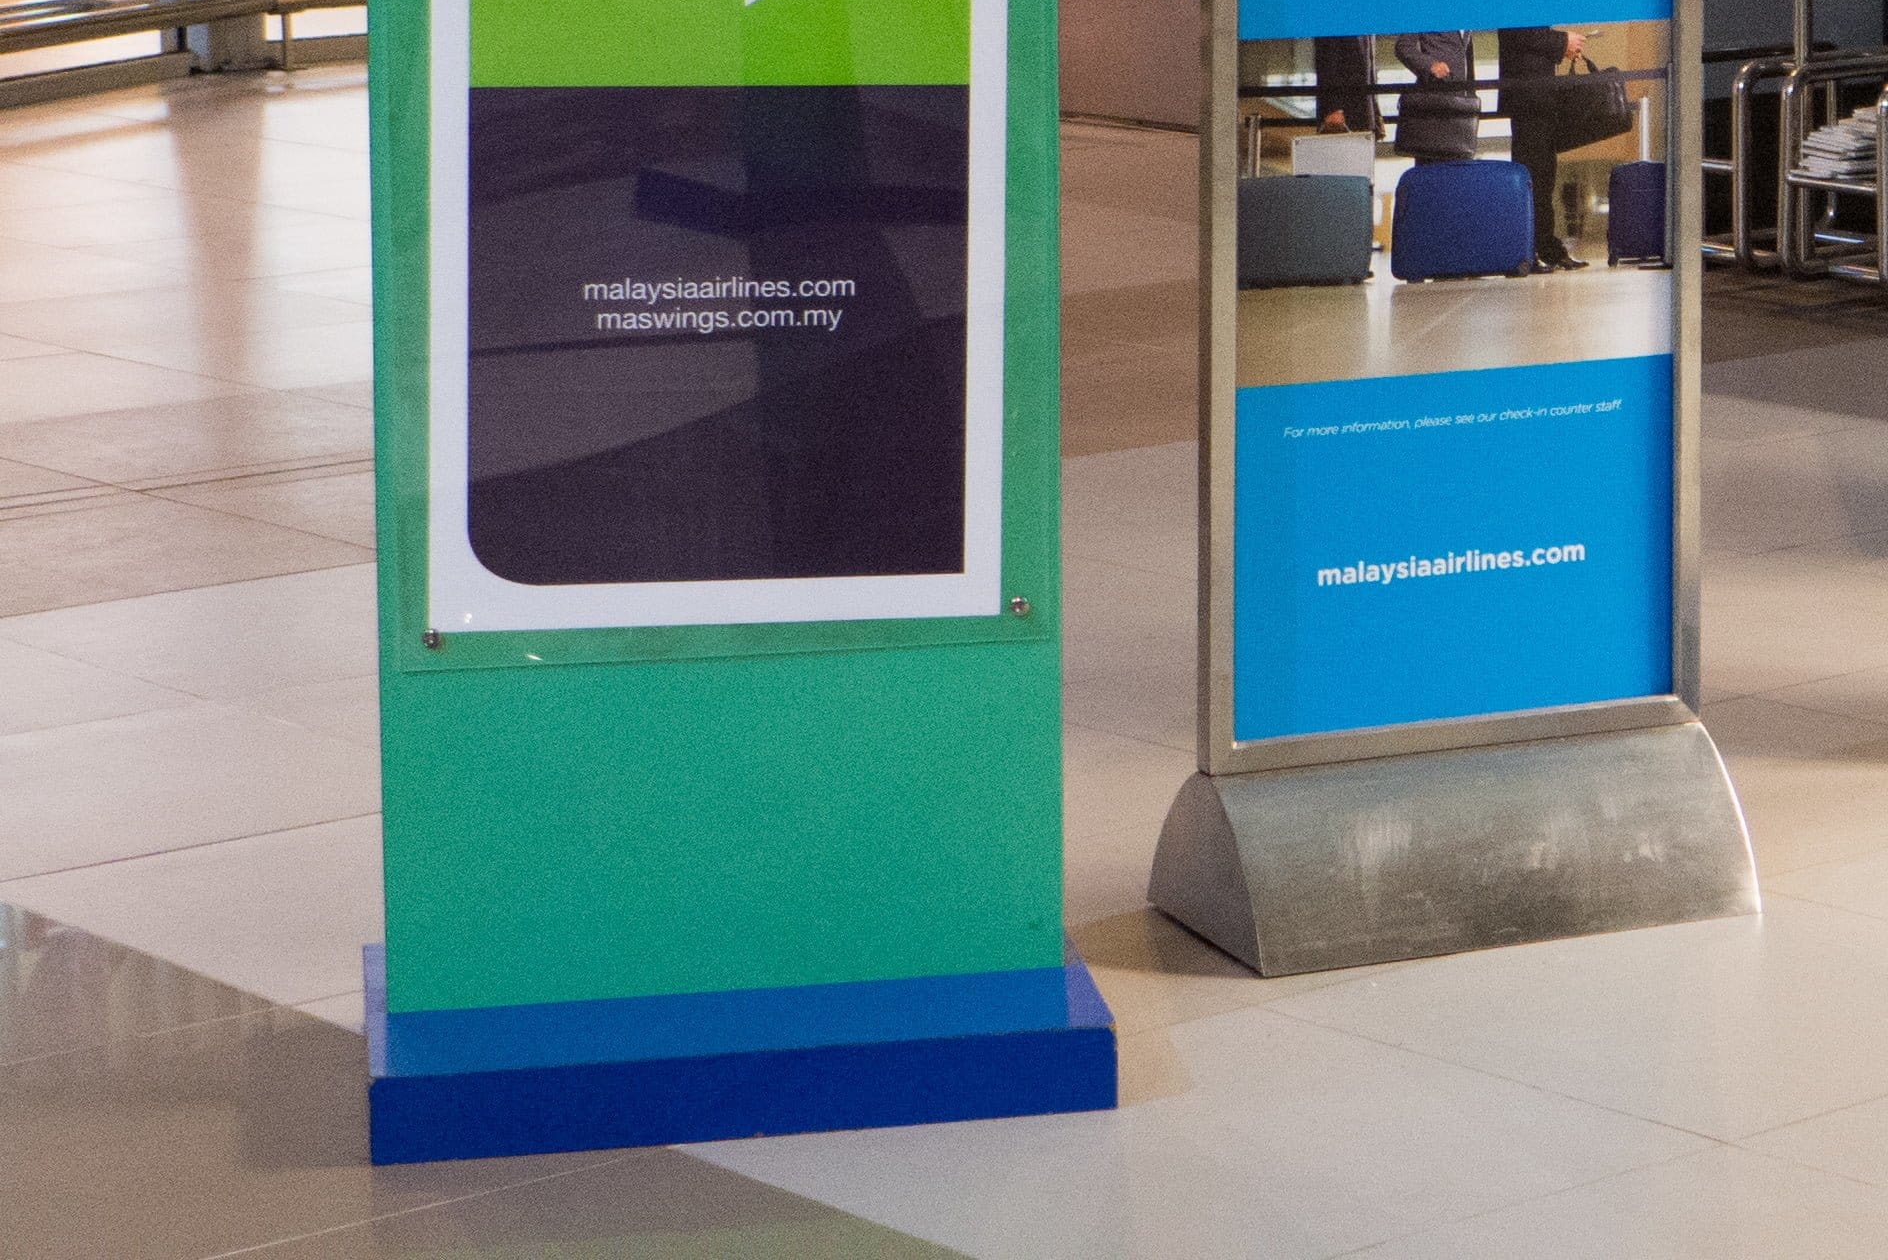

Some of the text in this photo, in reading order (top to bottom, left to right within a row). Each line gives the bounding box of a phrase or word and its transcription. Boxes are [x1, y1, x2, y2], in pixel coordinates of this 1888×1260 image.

[584, 276, 856, 304] malaysiaairlines.com
[597, 307, 844, 333] maswings.com.my
[1283, 427, 1304, 439] For
[1307, 425, 1339, 437] more
[1341, 418, 1412, 435] information,
[1414, 413, 1452, 429] please
[1455, 412, 1475, 425] see
[1477, 411, 1497, 424] our
[1499, 405, 1548, 421] check-in
[1550, 402, 1593, 417] counter
[1317, 543, 1587, 587] malaysiaairlines.com
